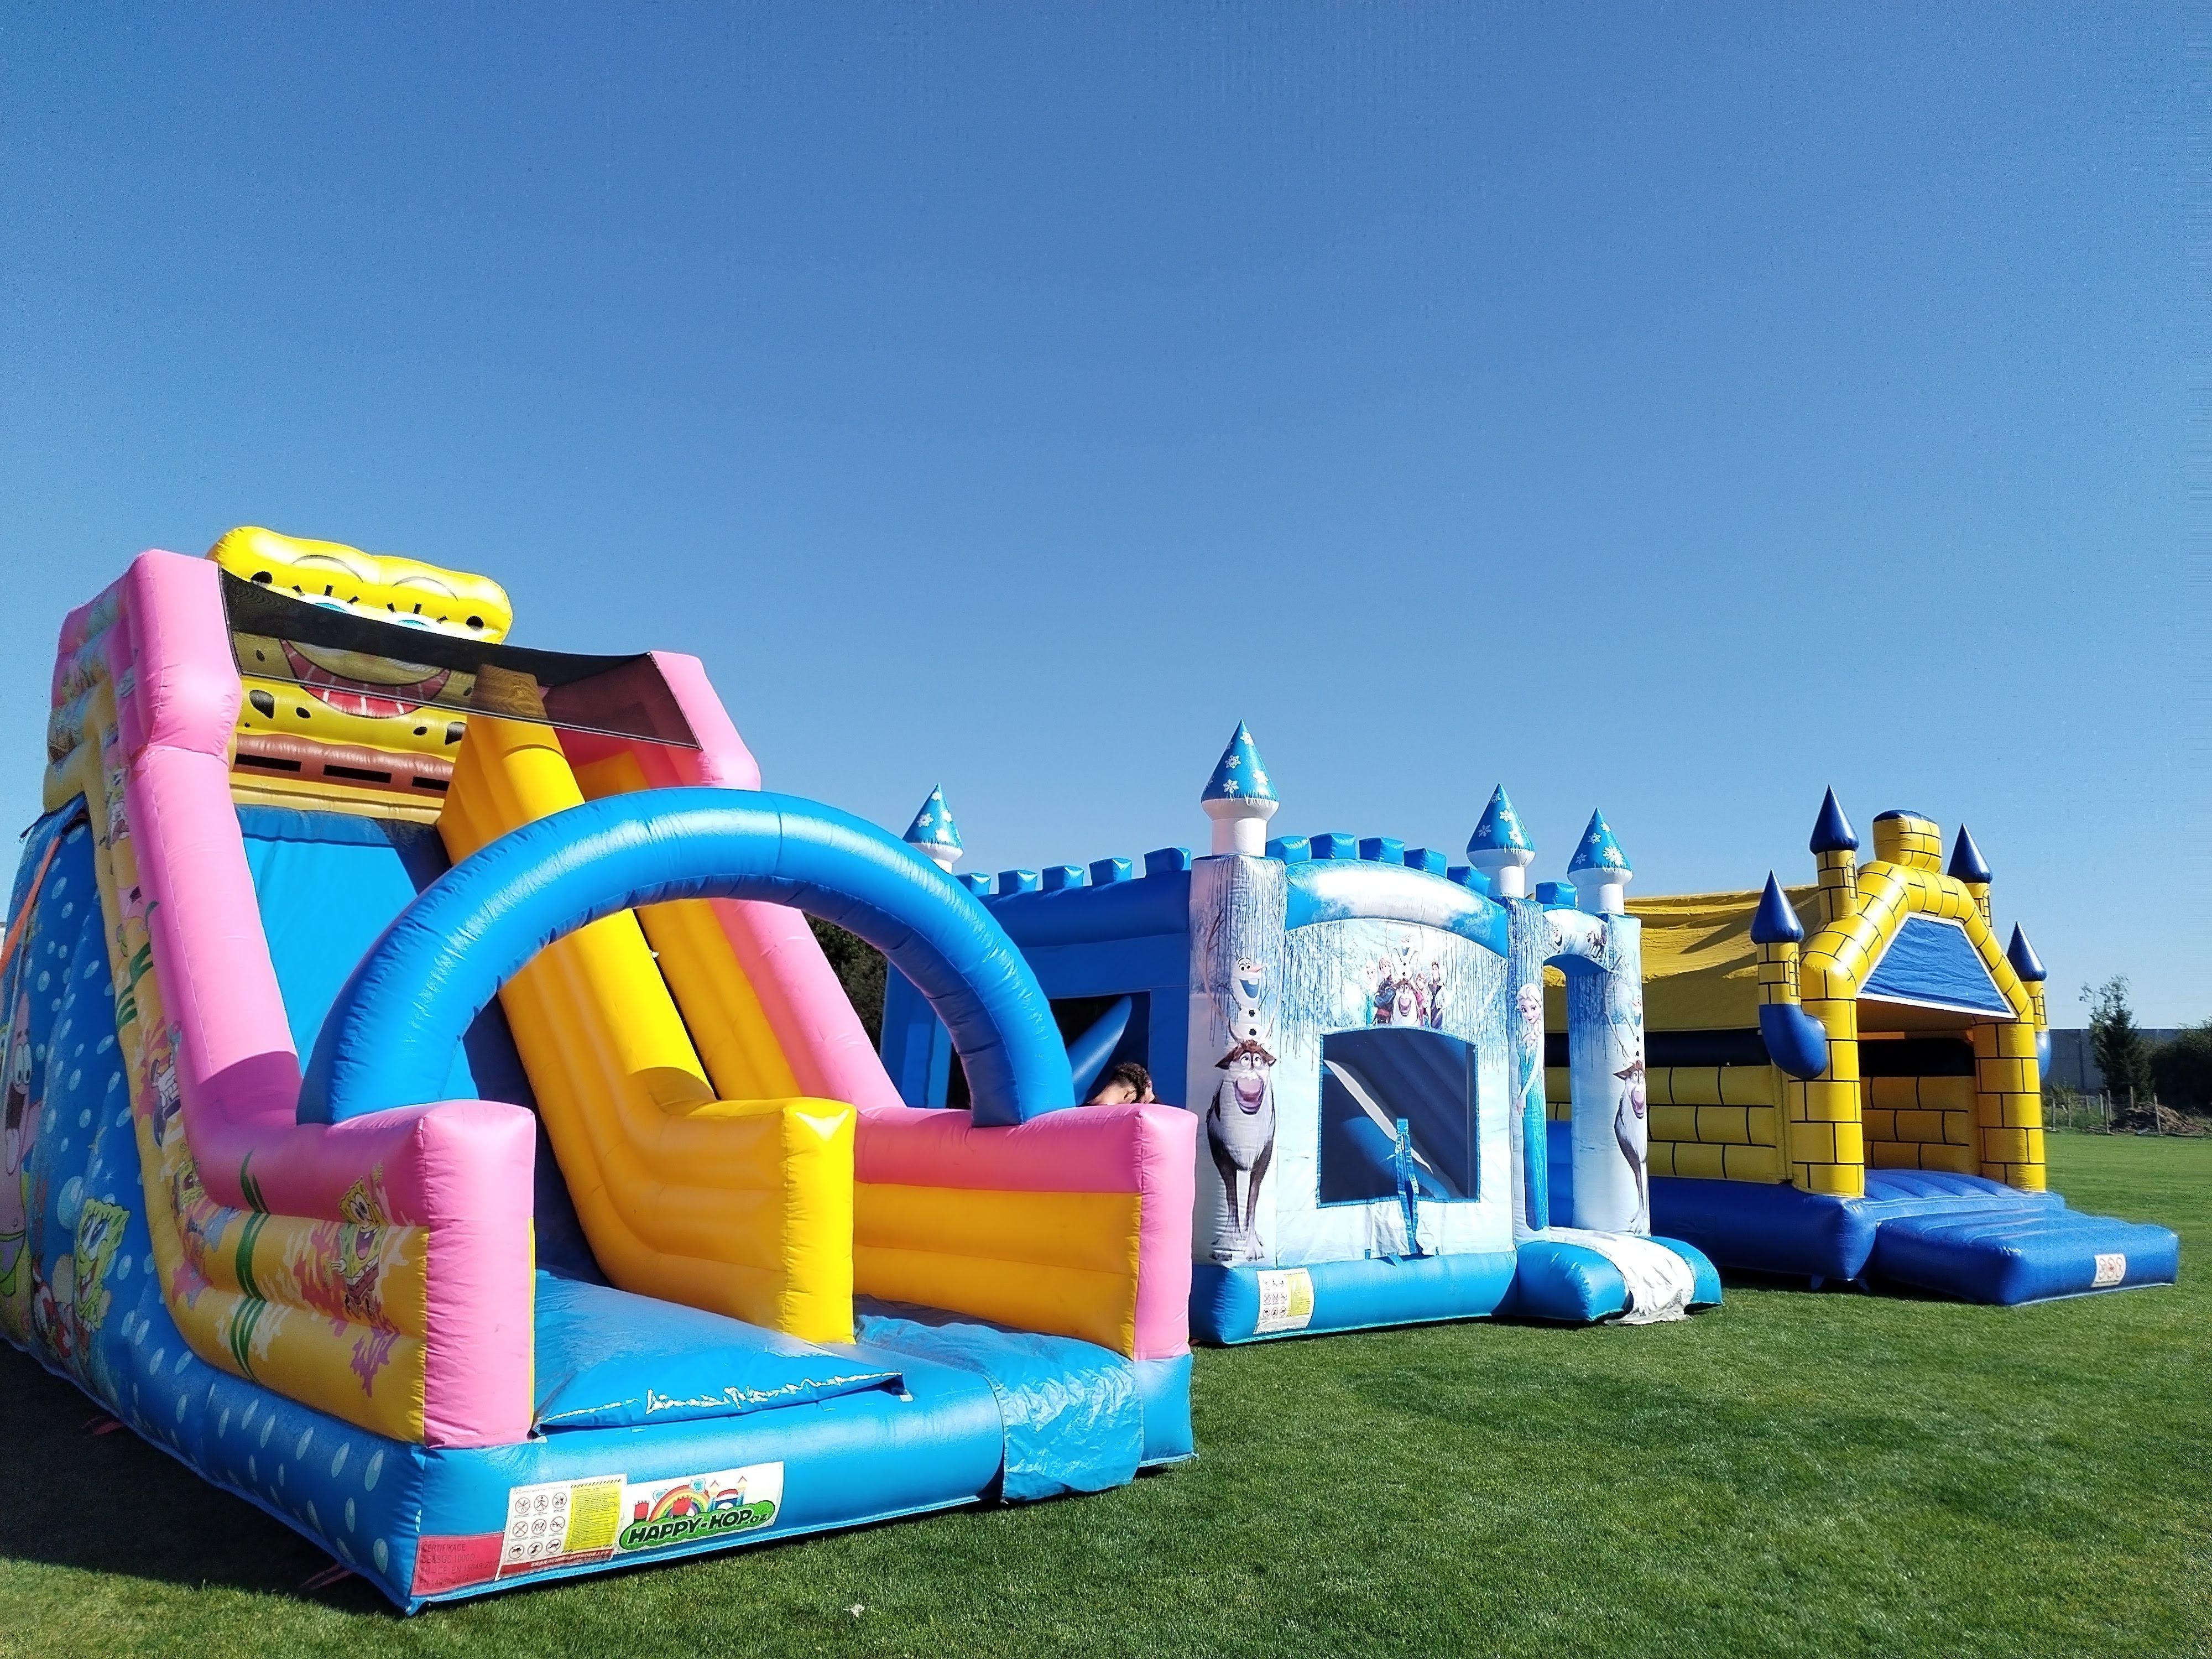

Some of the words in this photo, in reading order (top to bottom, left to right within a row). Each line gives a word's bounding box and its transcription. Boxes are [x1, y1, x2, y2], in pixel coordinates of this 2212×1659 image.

[422, 1544, 466, 1552] CERTIFIKACE
[422, 1555, 452, 1563] CE&SGS
[451, 1566, 461, 1575] EN
